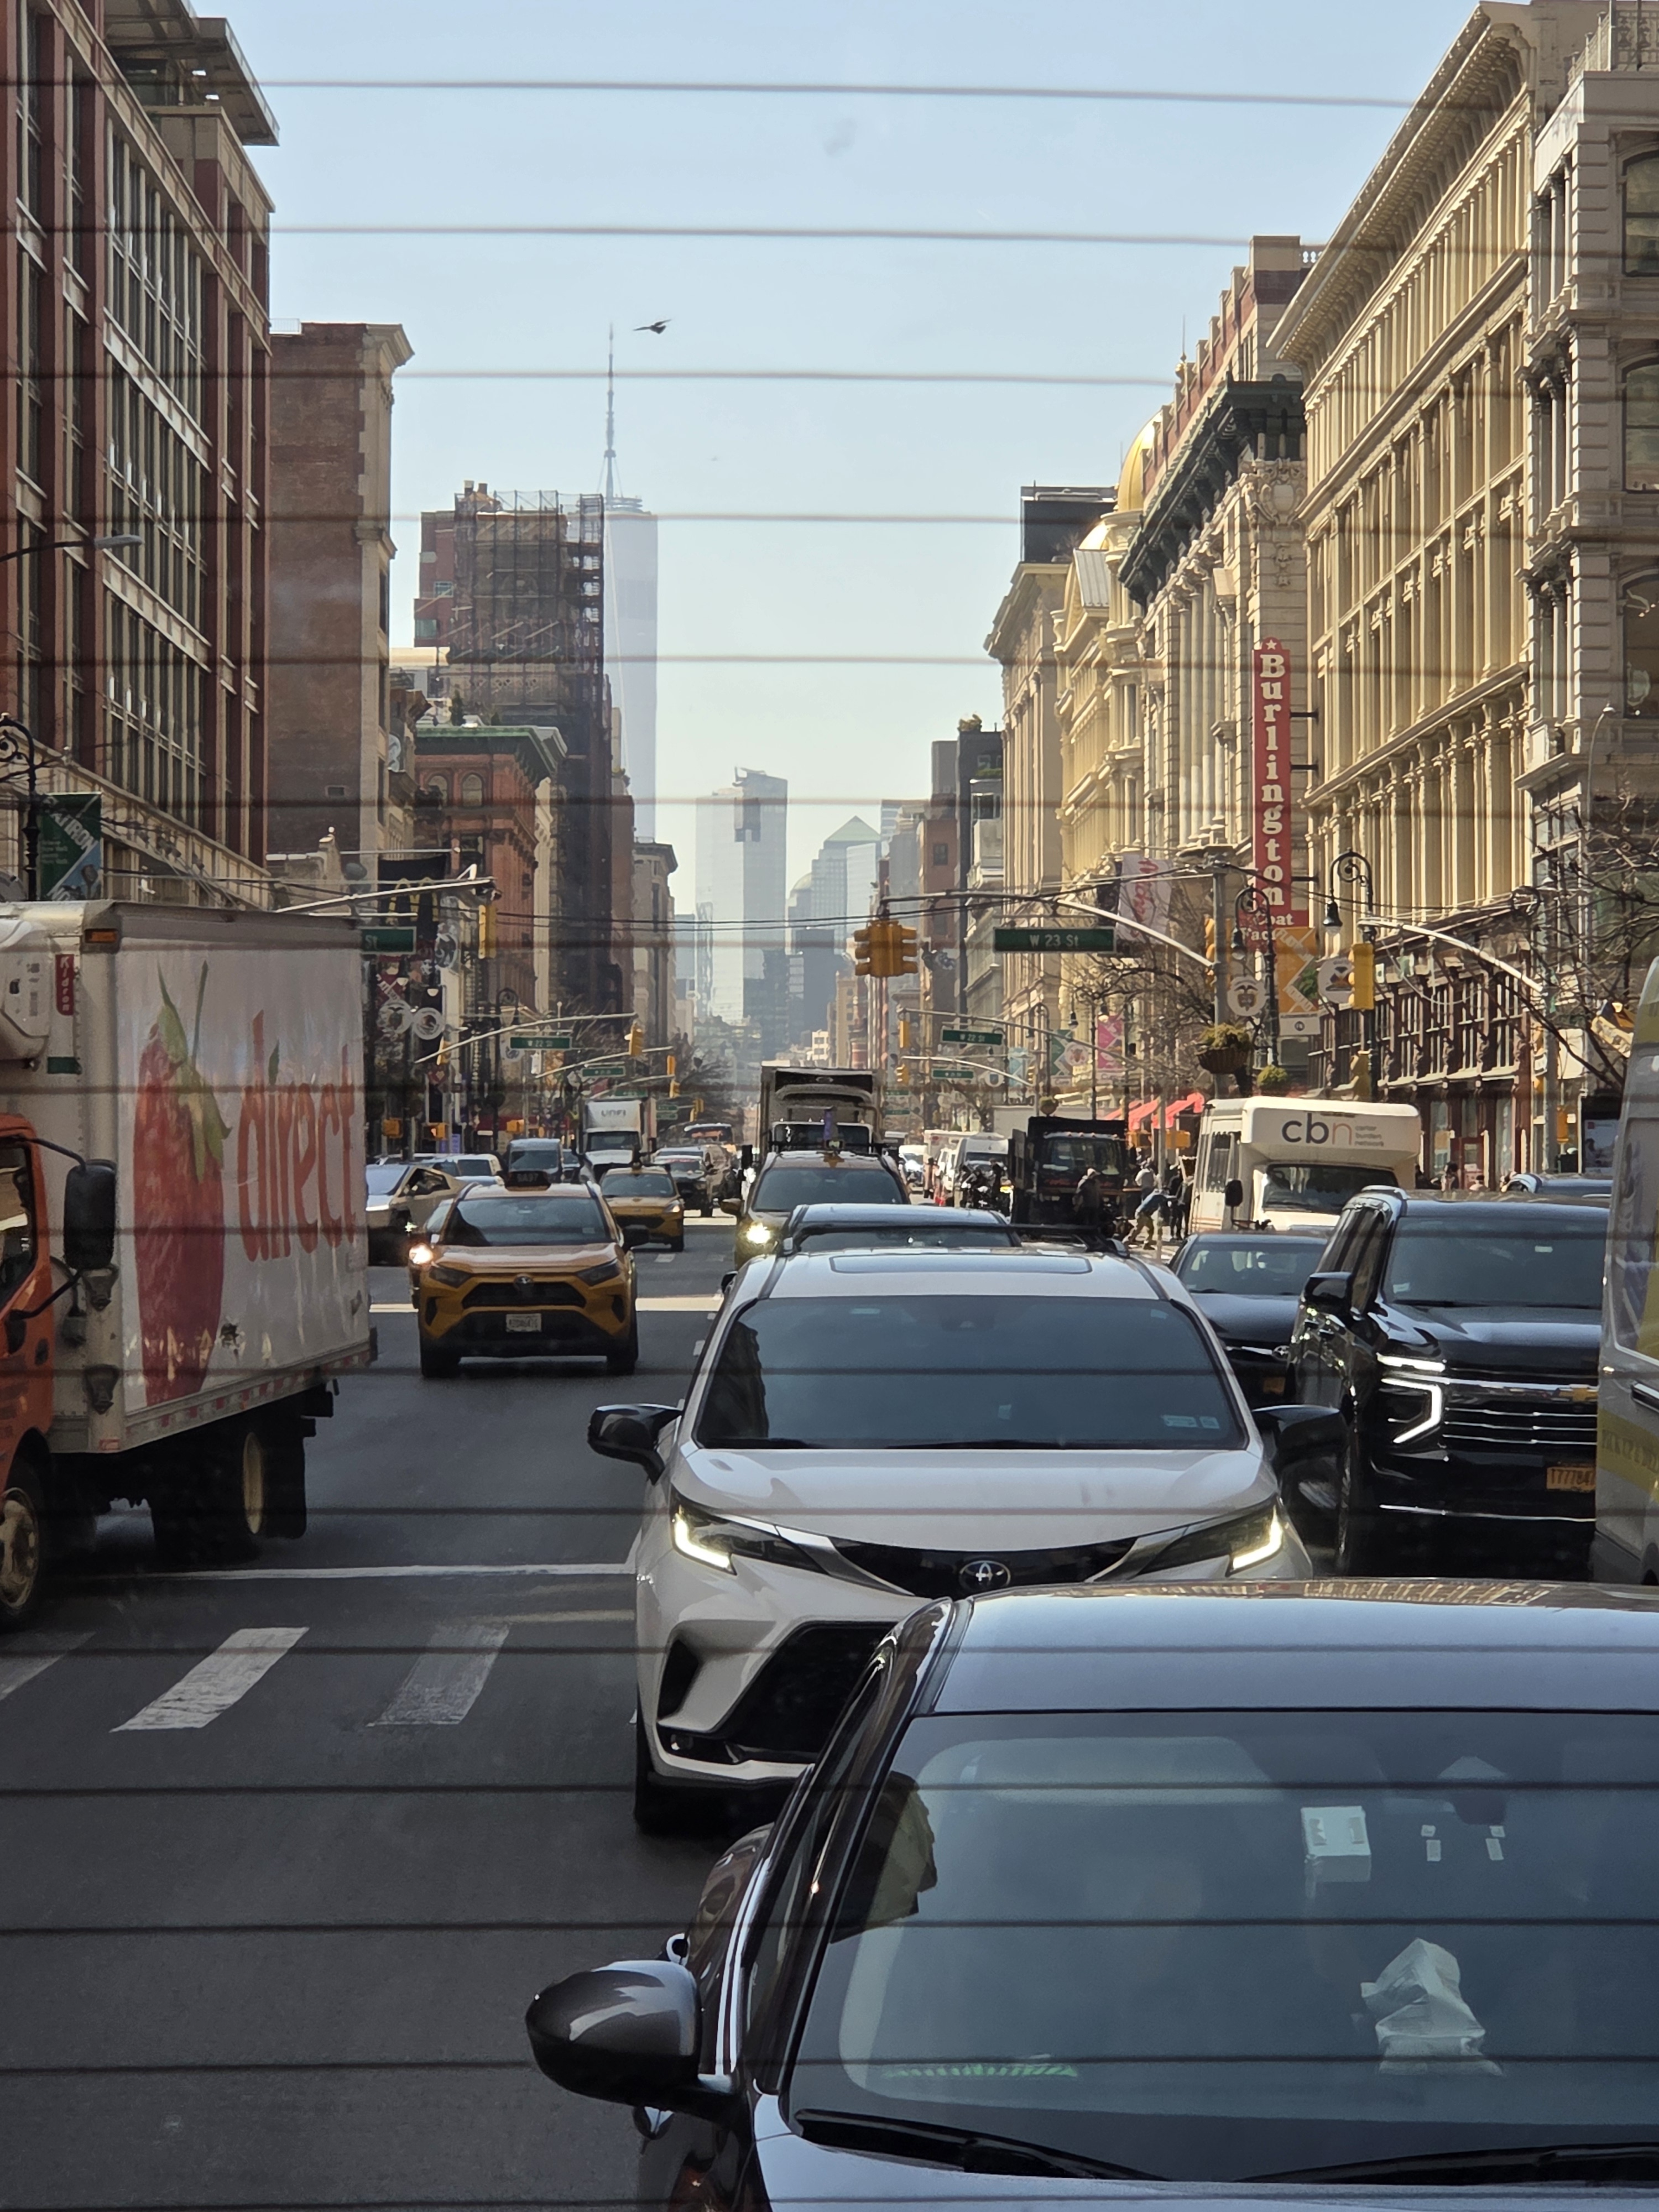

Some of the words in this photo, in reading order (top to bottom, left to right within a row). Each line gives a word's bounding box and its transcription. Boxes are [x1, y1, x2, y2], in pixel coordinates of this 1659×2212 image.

[1260, 654, 1285, 906] Burlington
[1029, 935, 1040, 947] W
[1045, 934, 1061, 947] 23
[1066, 935, 1079, 947] St
[59, 956, 70, 1011] Kidron
[1281, 1113, 1352, 1145] cbn
